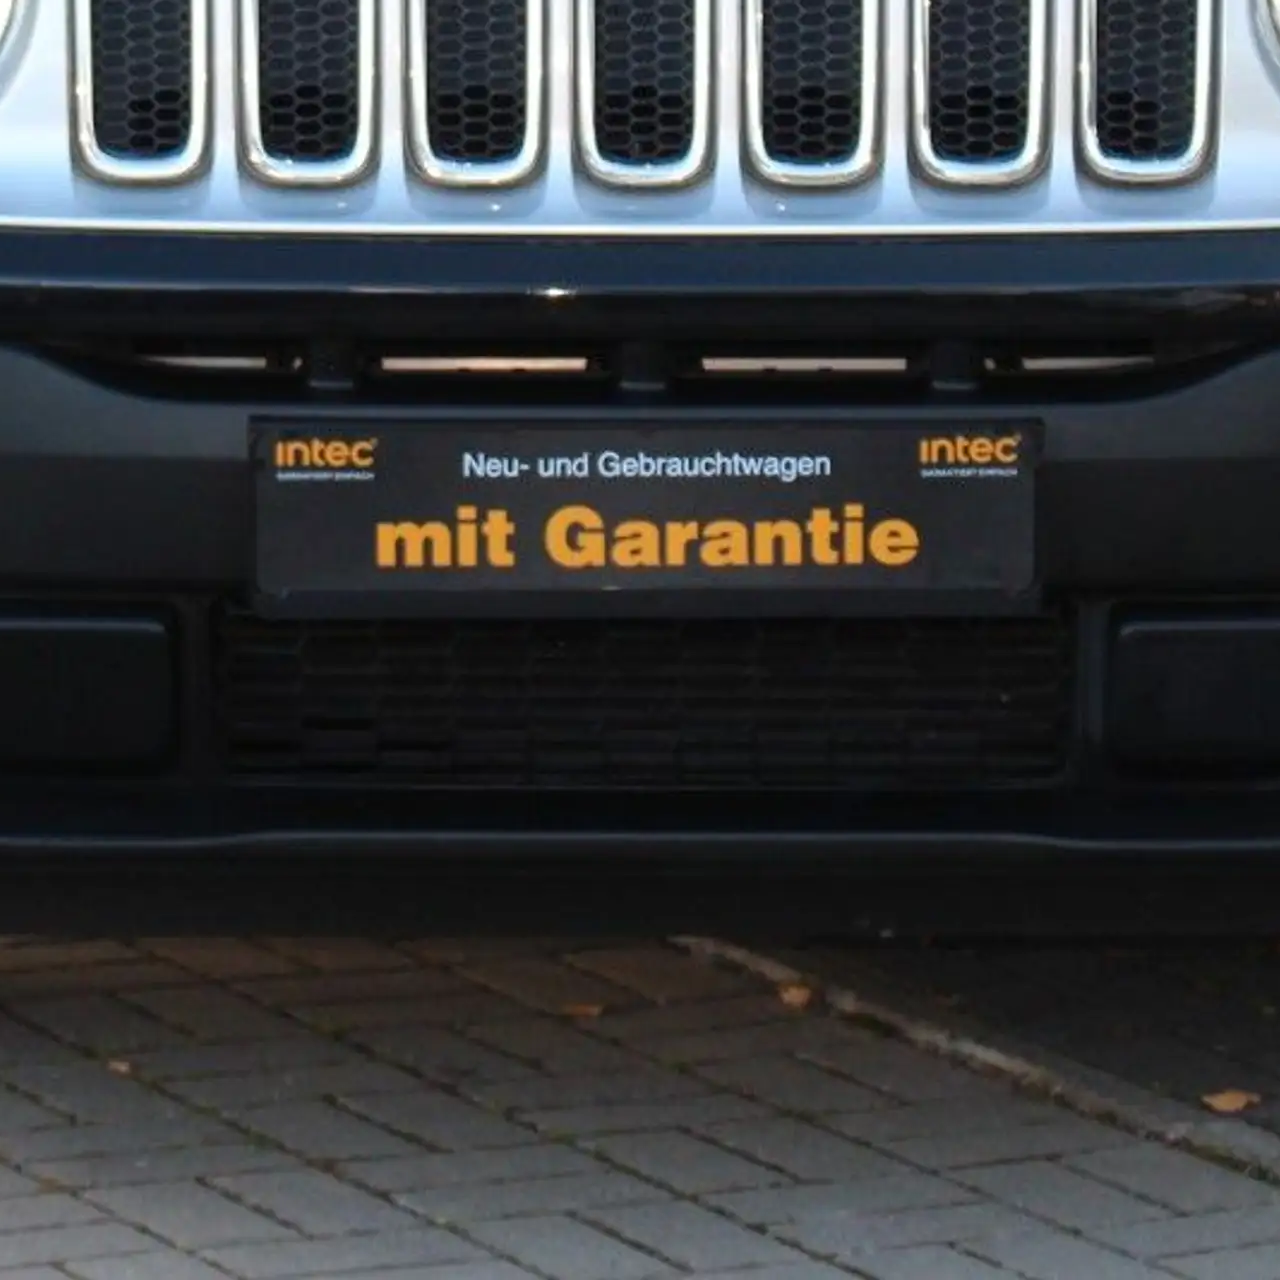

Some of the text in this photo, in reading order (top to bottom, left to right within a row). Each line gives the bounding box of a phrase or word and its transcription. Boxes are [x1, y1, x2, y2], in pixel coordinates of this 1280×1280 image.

[275, 438, 375, 468] intec
[920, 435, 1019, 465] intec
[462, 450, 831, 483] Neu- und Gebrauchtwagen
[376, 503, 920, 568] mit Garantie
